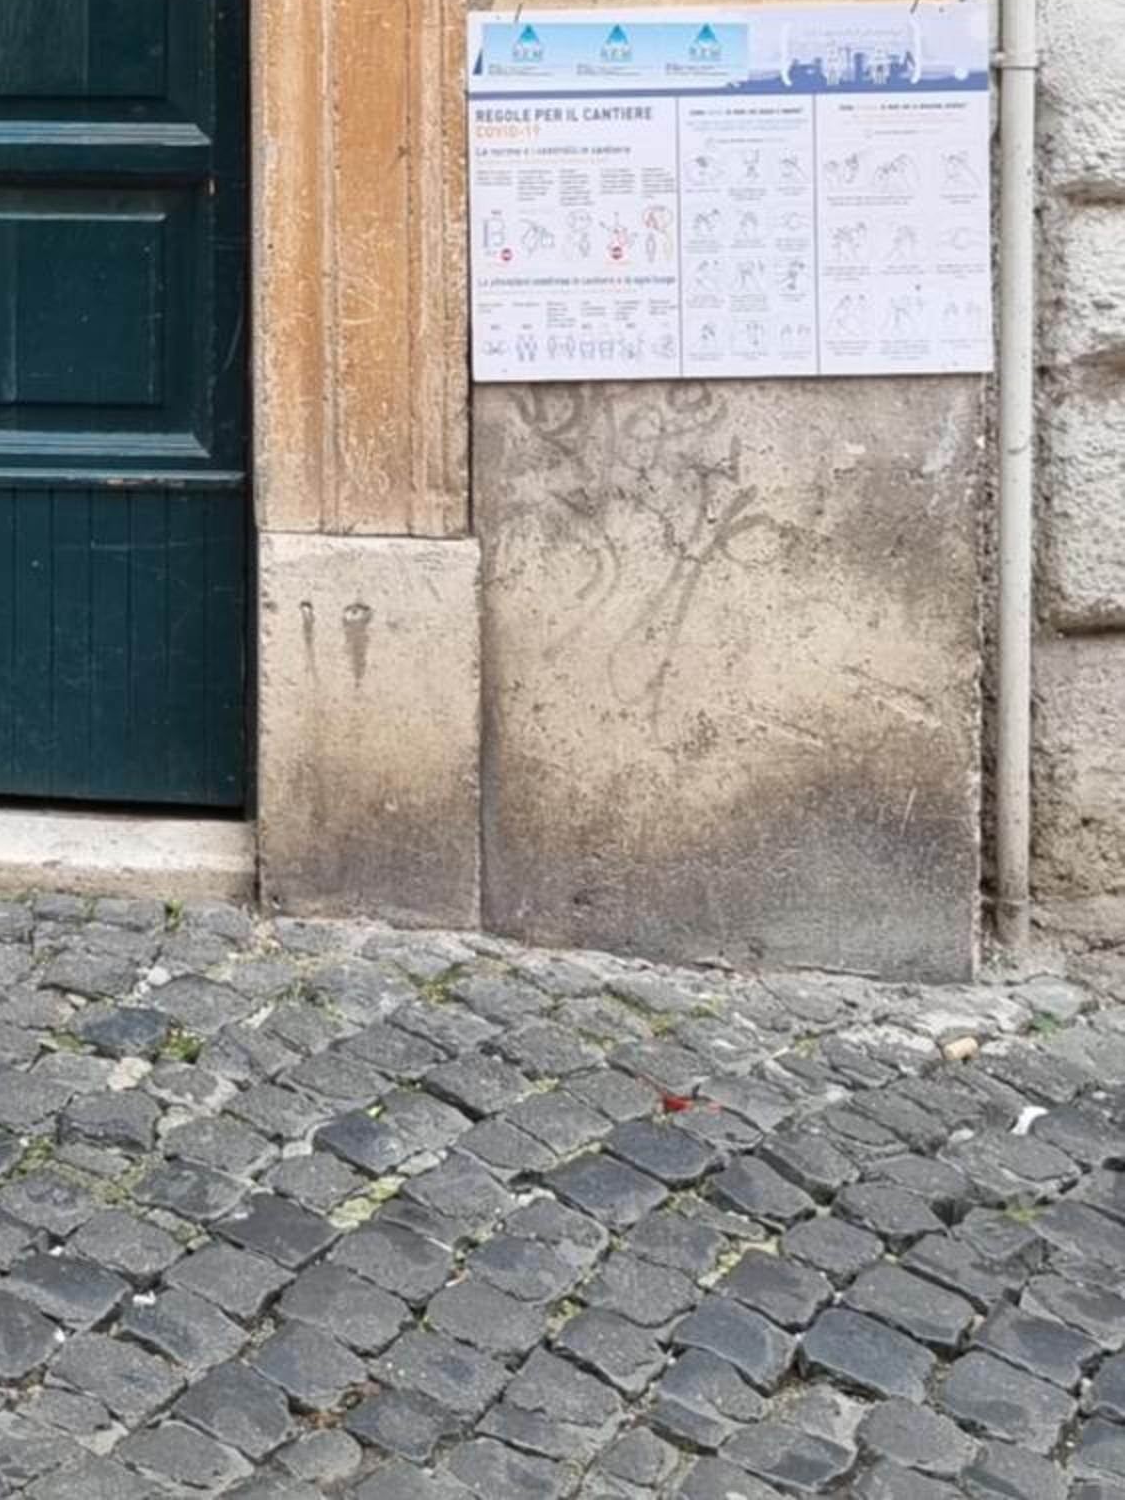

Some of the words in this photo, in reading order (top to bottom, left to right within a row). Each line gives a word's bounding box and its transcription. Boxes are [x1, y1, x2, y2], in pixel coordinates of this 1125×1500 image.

[475, 107, 532, 124] REGOLE
[535, 107, 562, 122] PER
[566, 107, 579, 122] IL
[582, 105, 653, 121] CANTIERE
[476, 124, 541, 139] COVID-19
